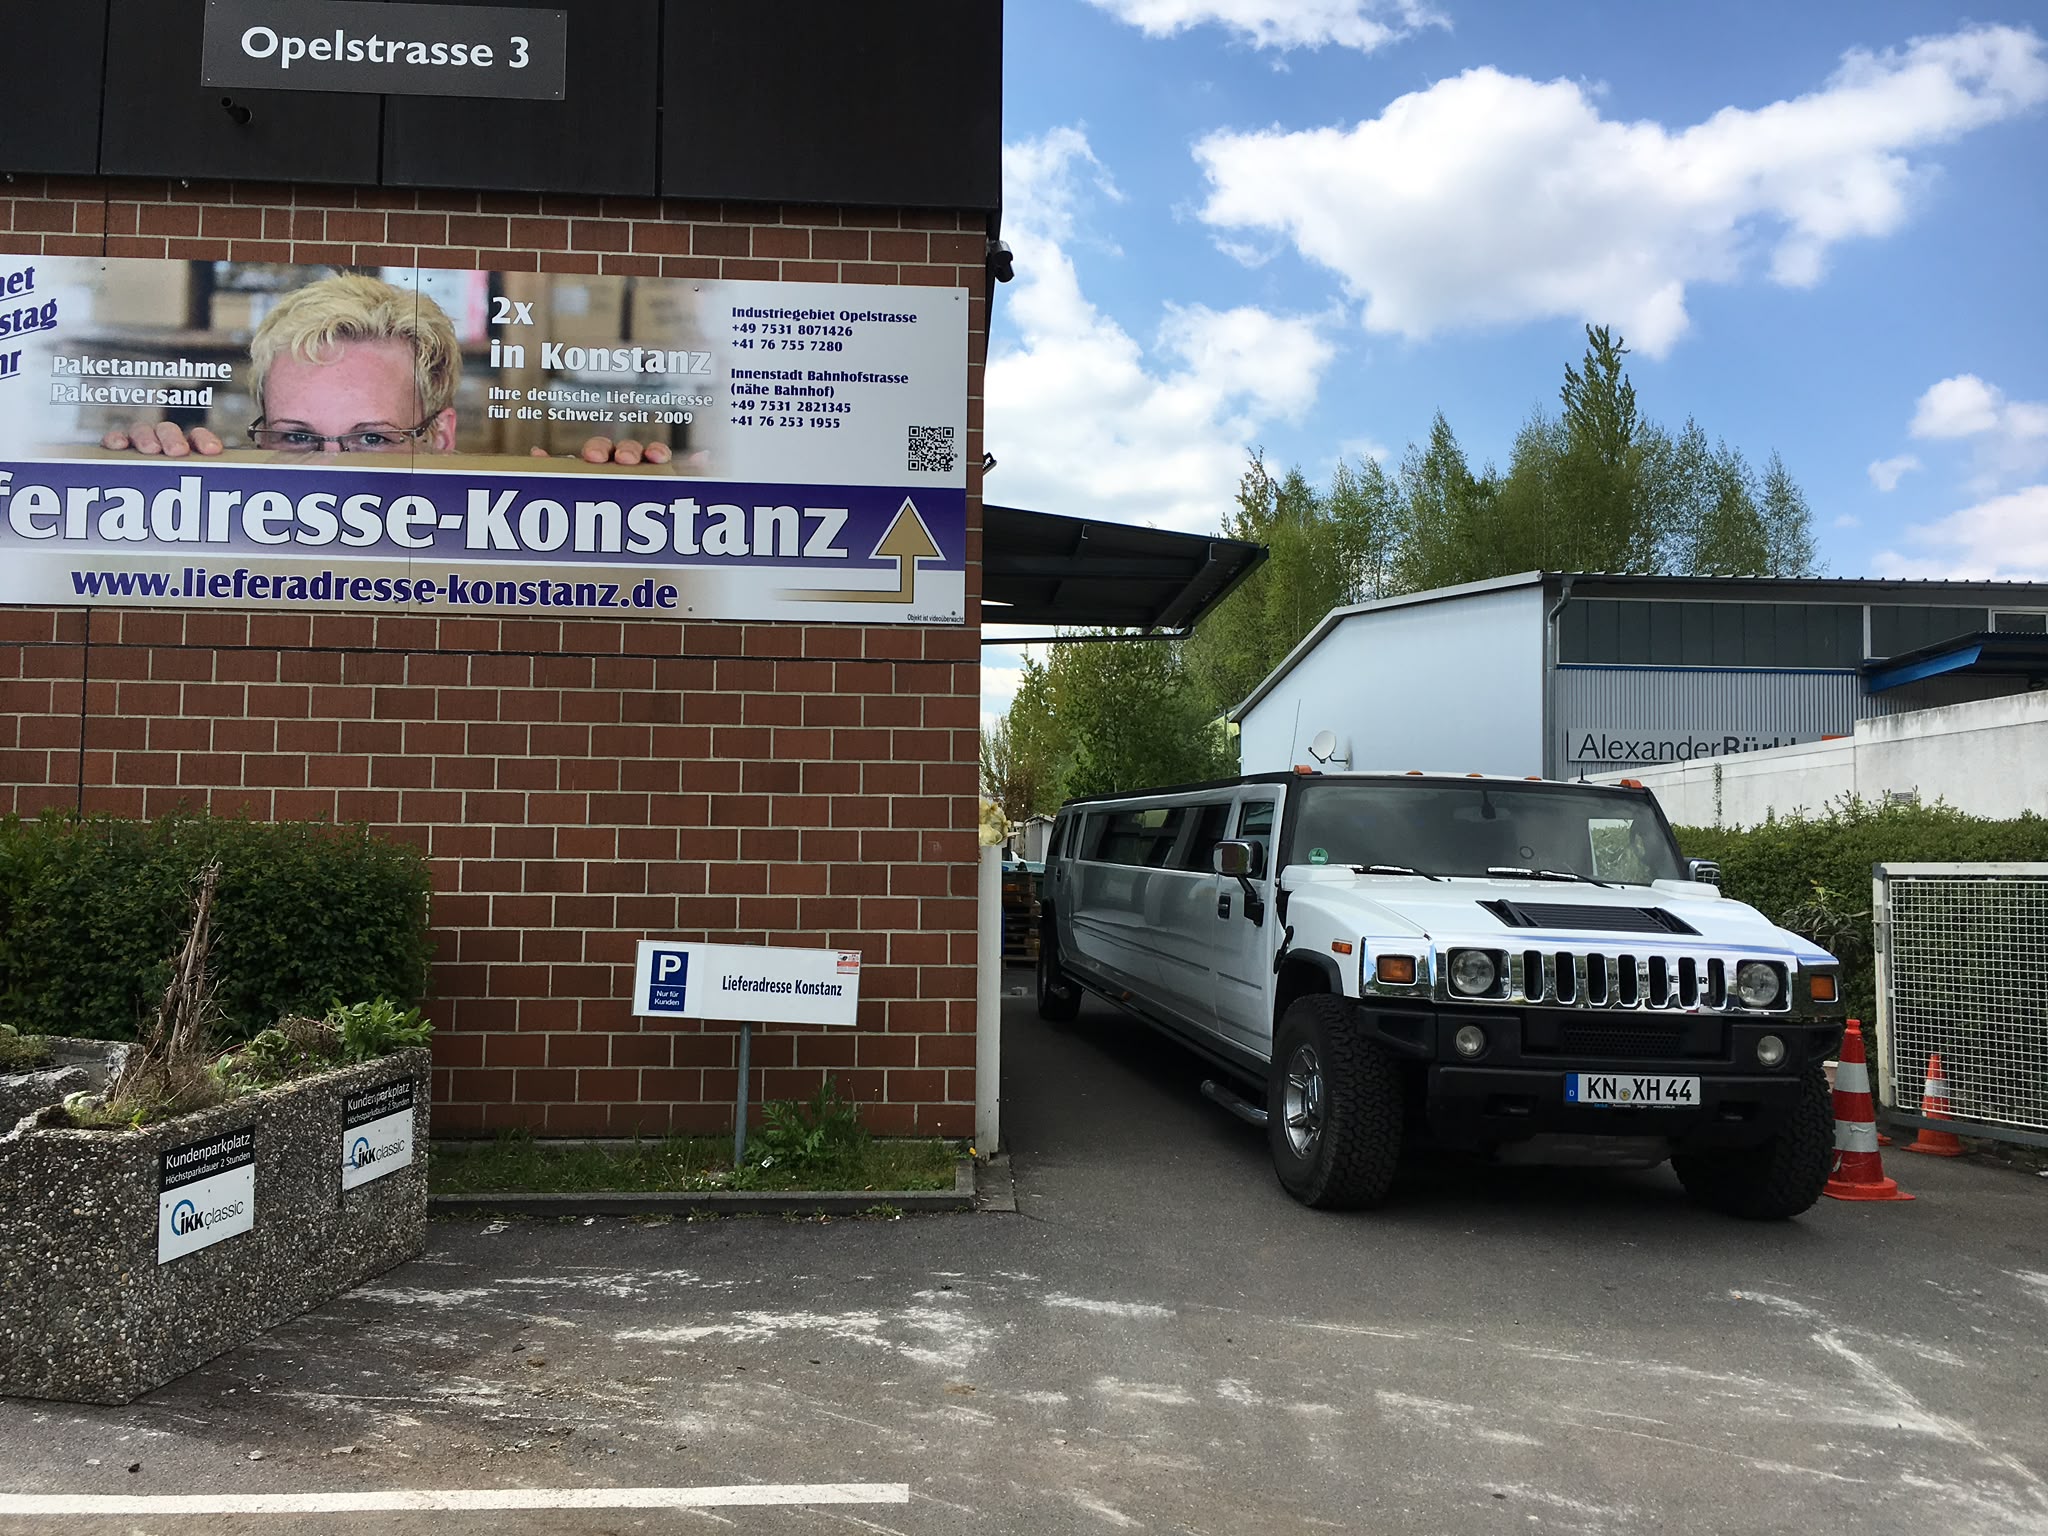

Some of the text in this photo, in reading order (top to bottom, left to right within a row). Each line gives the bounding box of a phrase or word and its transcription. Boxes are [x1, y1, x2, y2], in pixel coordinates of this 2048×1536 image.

[241, 26, 529, 69] Opelstrasse 3
[0, 266, 35, 297] et
[491, 296, 534, 325] 2x
[732, 307, 917, 323] Industriegebiet Opelstrasse
[732, 323, 853, 337] +49 7531 8071426
[490, 338, 712, 375] in Konstanz
[732, 339, 843, 352] +41 76 755 7280
[52, 355, 232, 379] Paketannahme
[731, 368, 909, 384] Innenstadt Bahnhofstrasse
[51, 383, 213, 406] Paketversand
[488, 387, 713, 406] Ihre deutsche Lieferadresse
[730, 383, 835, 398] (nähe Bahnhof)
[488, 405, 693, 425] für die Schweiz seit 2009
[730, 400, 851, 413] +49 7531 2821345
[730, 416, 840, 429] +41 76 253 1955
[70, 566, 678, 610] www.lieferadresse-konstanz.de
[907, 613, 922, 622] Objekt
[658, 954, 682, 982] P
[722, 975, 842, 996] Lieferadresse Konstanz
[347, 1083, 410, 1112] Kundenparkplatz
[1587, 1077, 1617, 1100] KN
[1632, 1078, 1661, 1101] XH
[1665, 1079, 1692, 1101] 44
[165, 1134, 251, 1170] Kundenparkplatz
[165, 1151, 251, 1185] Höchstparkdauer 2 Stunden
